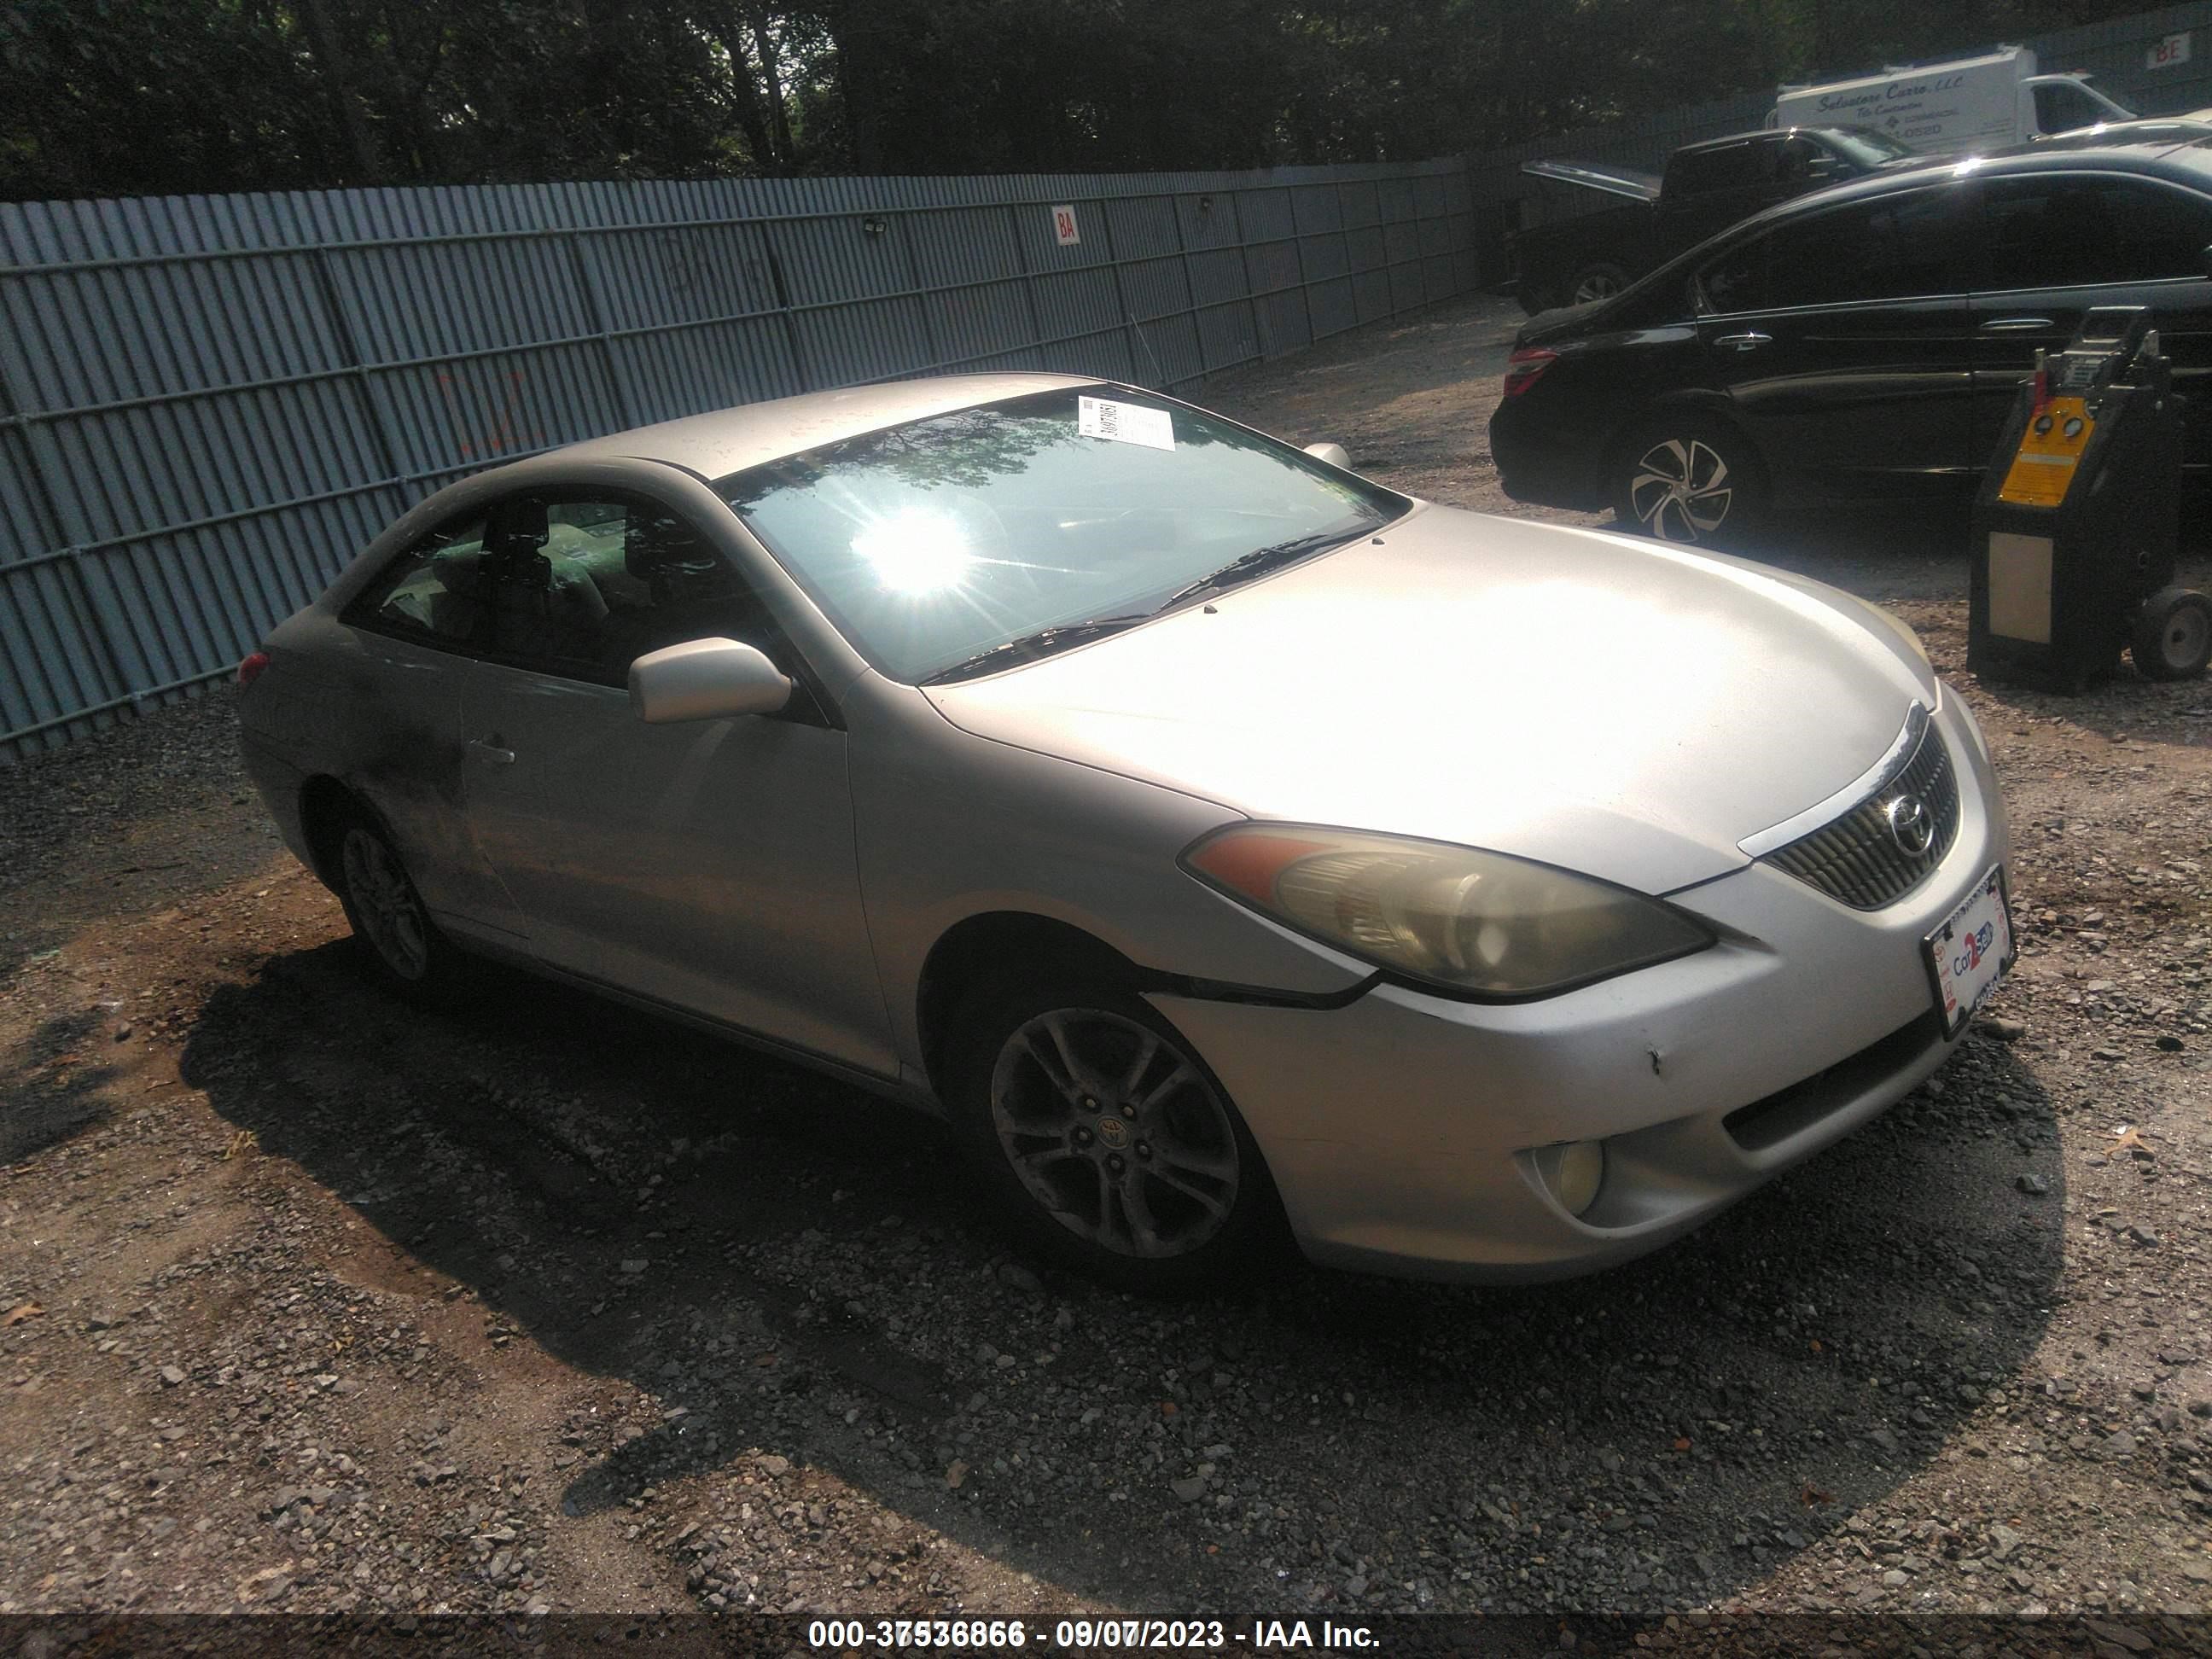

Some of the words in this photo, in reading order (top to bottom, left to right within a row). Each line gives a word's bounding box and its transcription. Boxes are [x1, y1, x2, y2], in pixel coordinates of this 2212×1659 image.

[2157, 38, 2180, 63] BE
[1816, 92, 1881, 113] Salvatore
[1936, 75, 1965, 91] LLC
[1057, 211, 1075, 239] BA
[1953, 923, 1994, 977] Car2Sell
